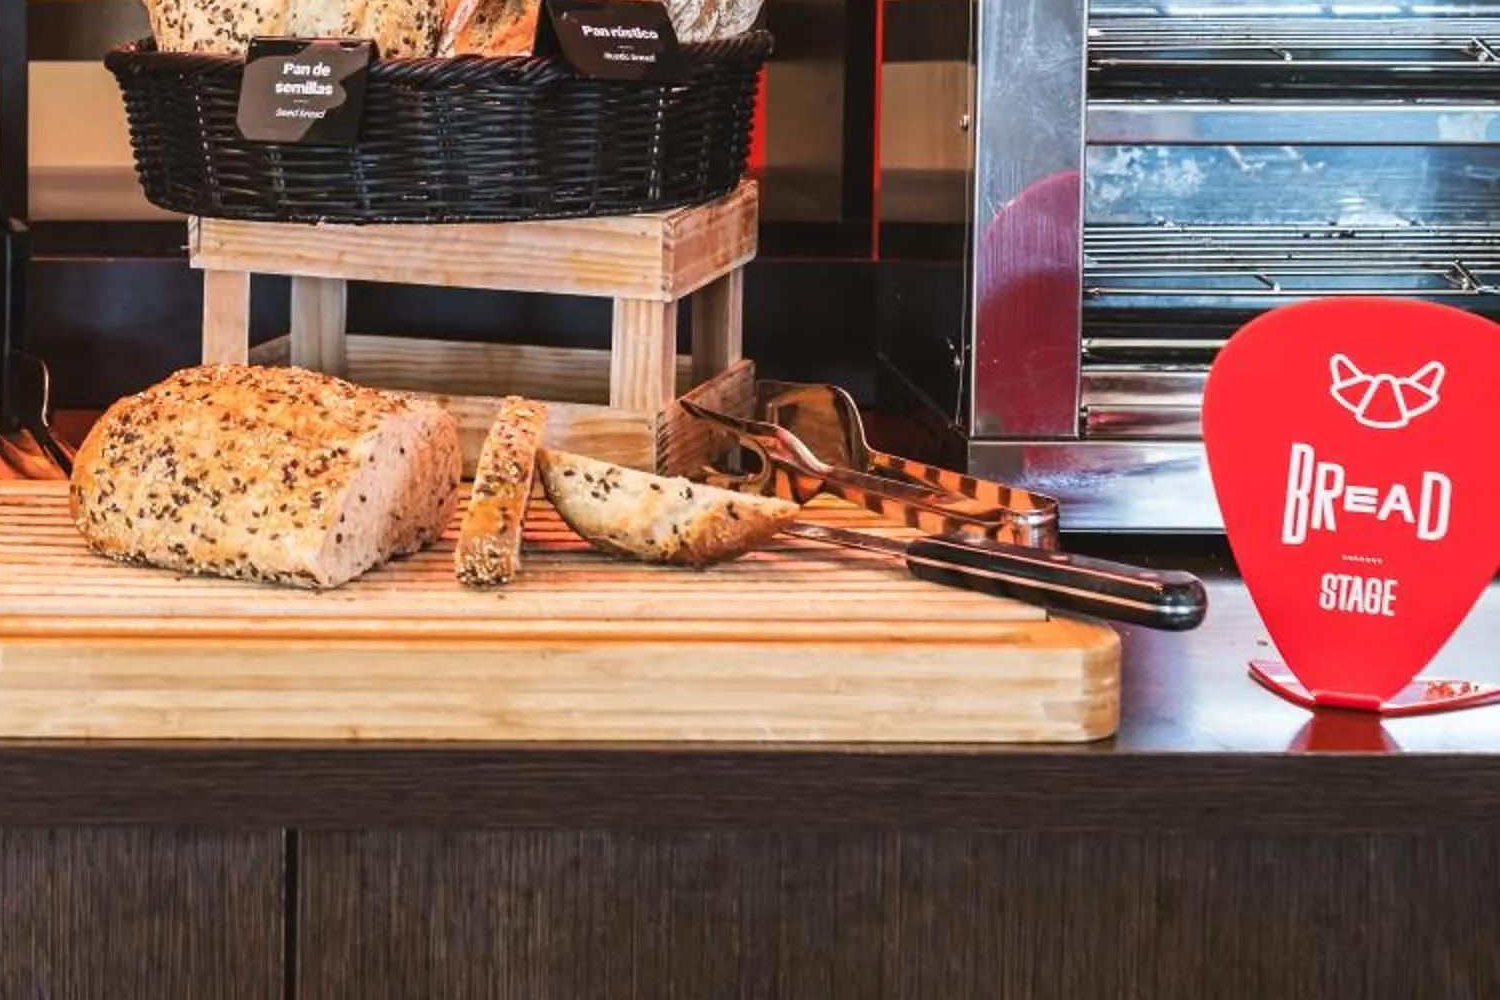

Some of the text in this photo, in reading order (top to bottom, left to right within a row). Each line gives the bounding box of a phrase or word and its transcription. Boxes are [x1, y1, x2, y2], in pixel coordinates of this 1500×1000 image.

[581, 25, 659, 40] Pan rústico
[282, 61, 332, 77] Pan de
[275, 80, 334, 96] semillas
[1281, 441, 1452, 546] BREAD
[1318, 571, 1399, 618] STAGE
